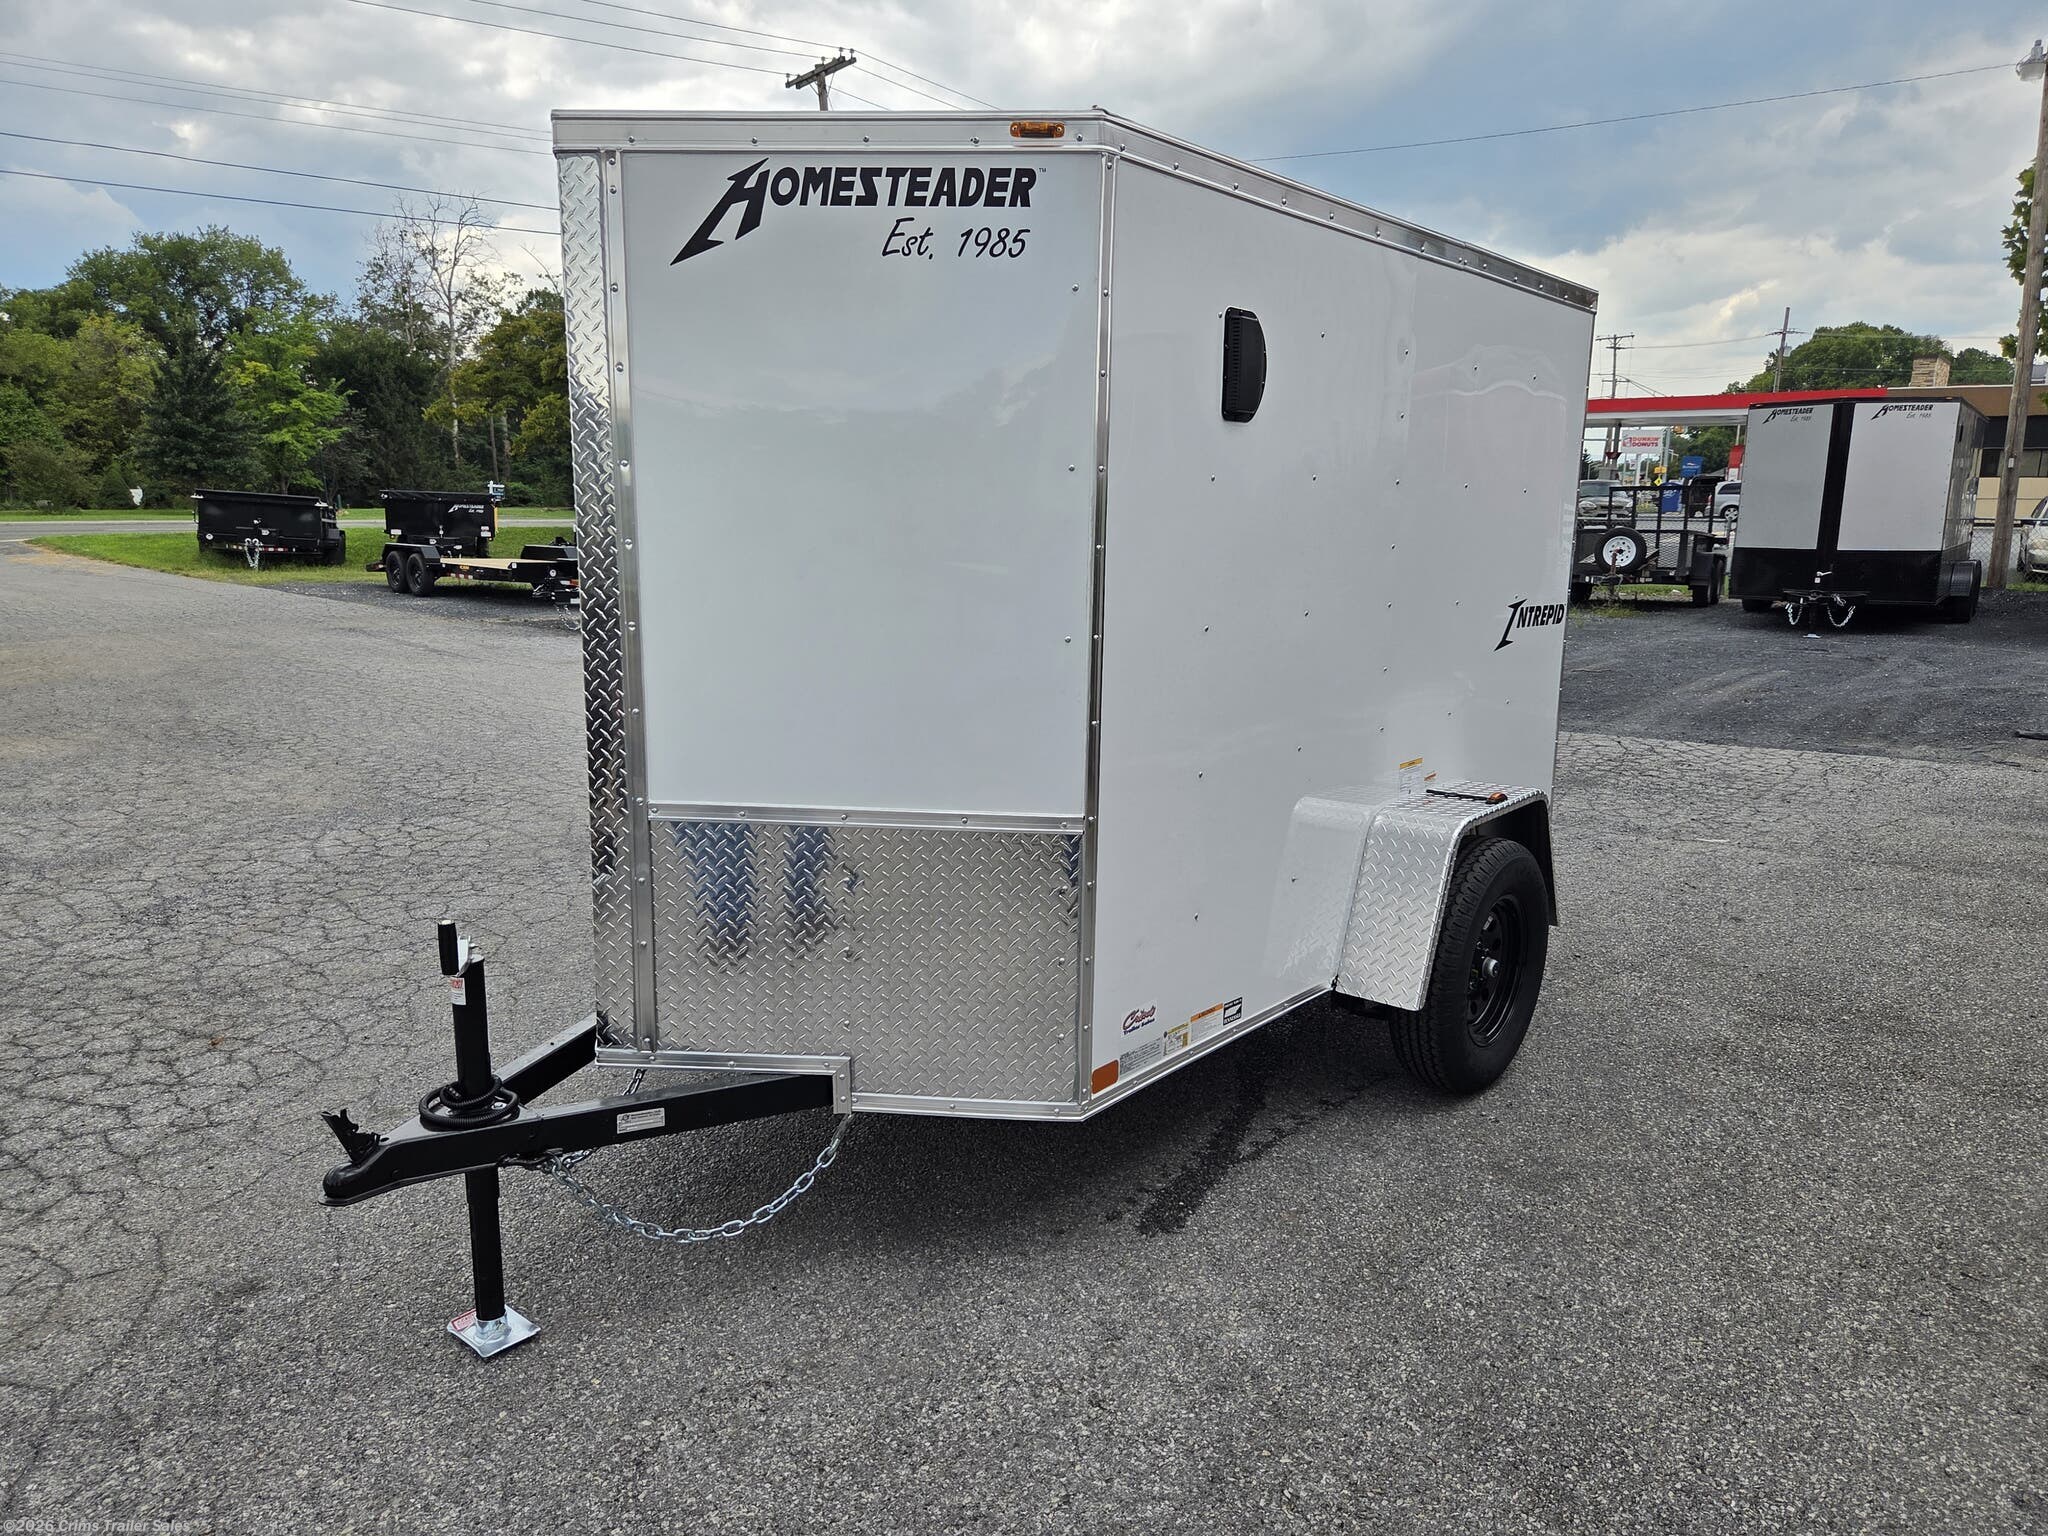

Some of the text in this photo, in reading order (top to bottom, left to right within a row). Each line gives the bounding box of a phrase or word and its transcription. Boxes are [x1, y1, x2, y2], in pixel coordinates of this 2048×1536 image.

[881, 217, 1032, 260] Est. 1985
[1871, 404, 1934, 421] HOMESTEADER
[1493, 598, 1565, 652] INTREPID
